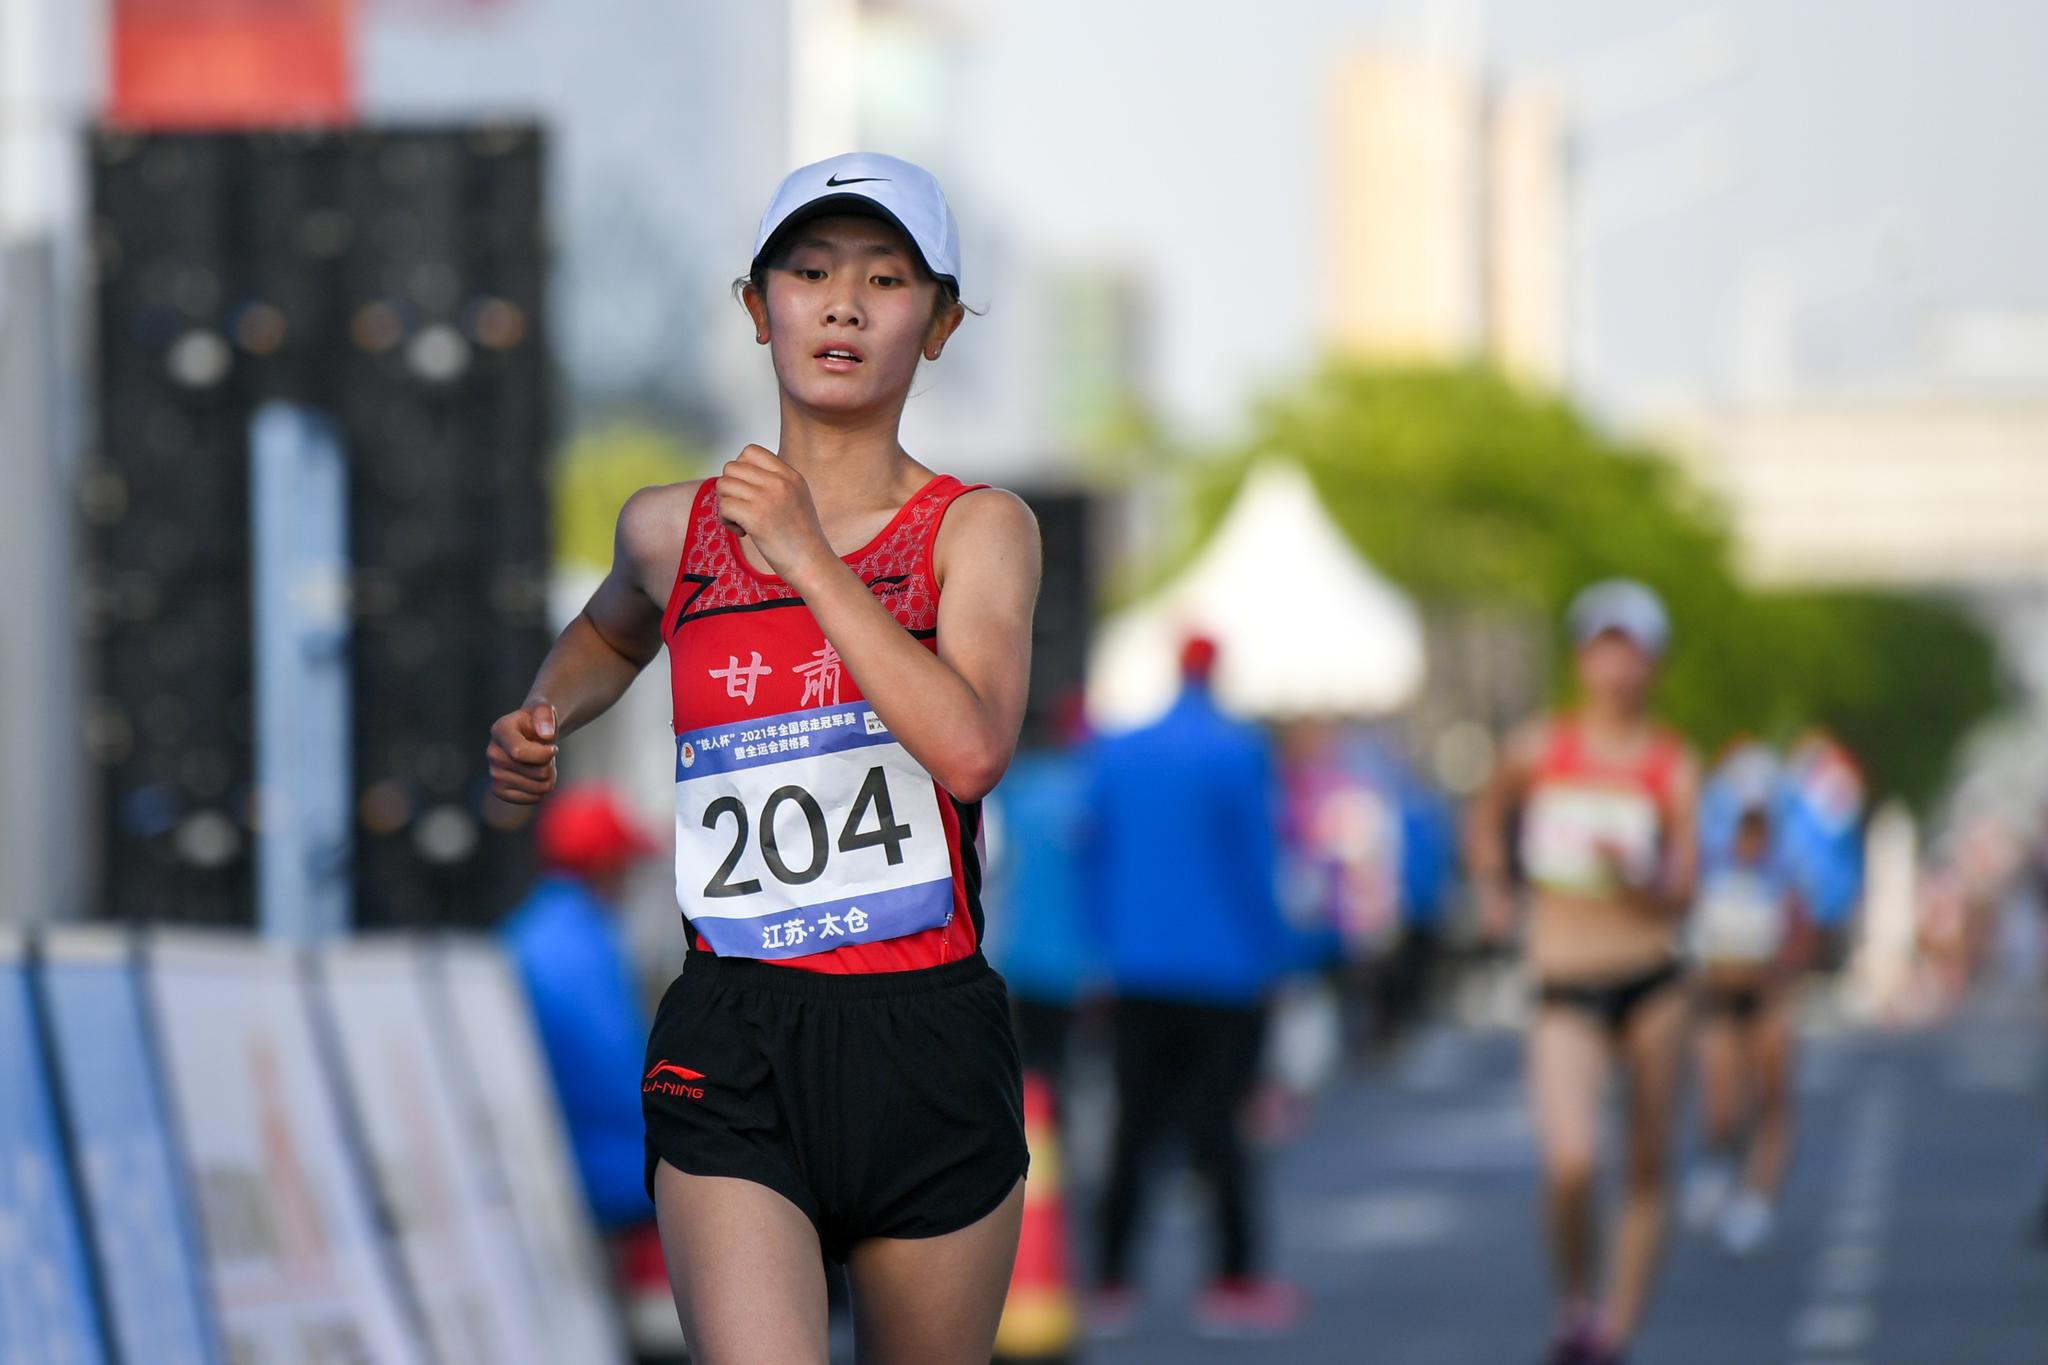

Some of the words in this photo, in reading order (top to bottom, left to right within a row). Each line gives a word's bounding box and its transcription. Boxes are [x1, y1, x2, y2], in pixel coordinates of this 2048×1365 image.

[708, 639, 843, 707] 甘肃
[734, 735, 810, 761] 暨全运会资格赛
[702, 765, 912, 899] 204
[761, 907, 870, 950] 江苏·太仓
